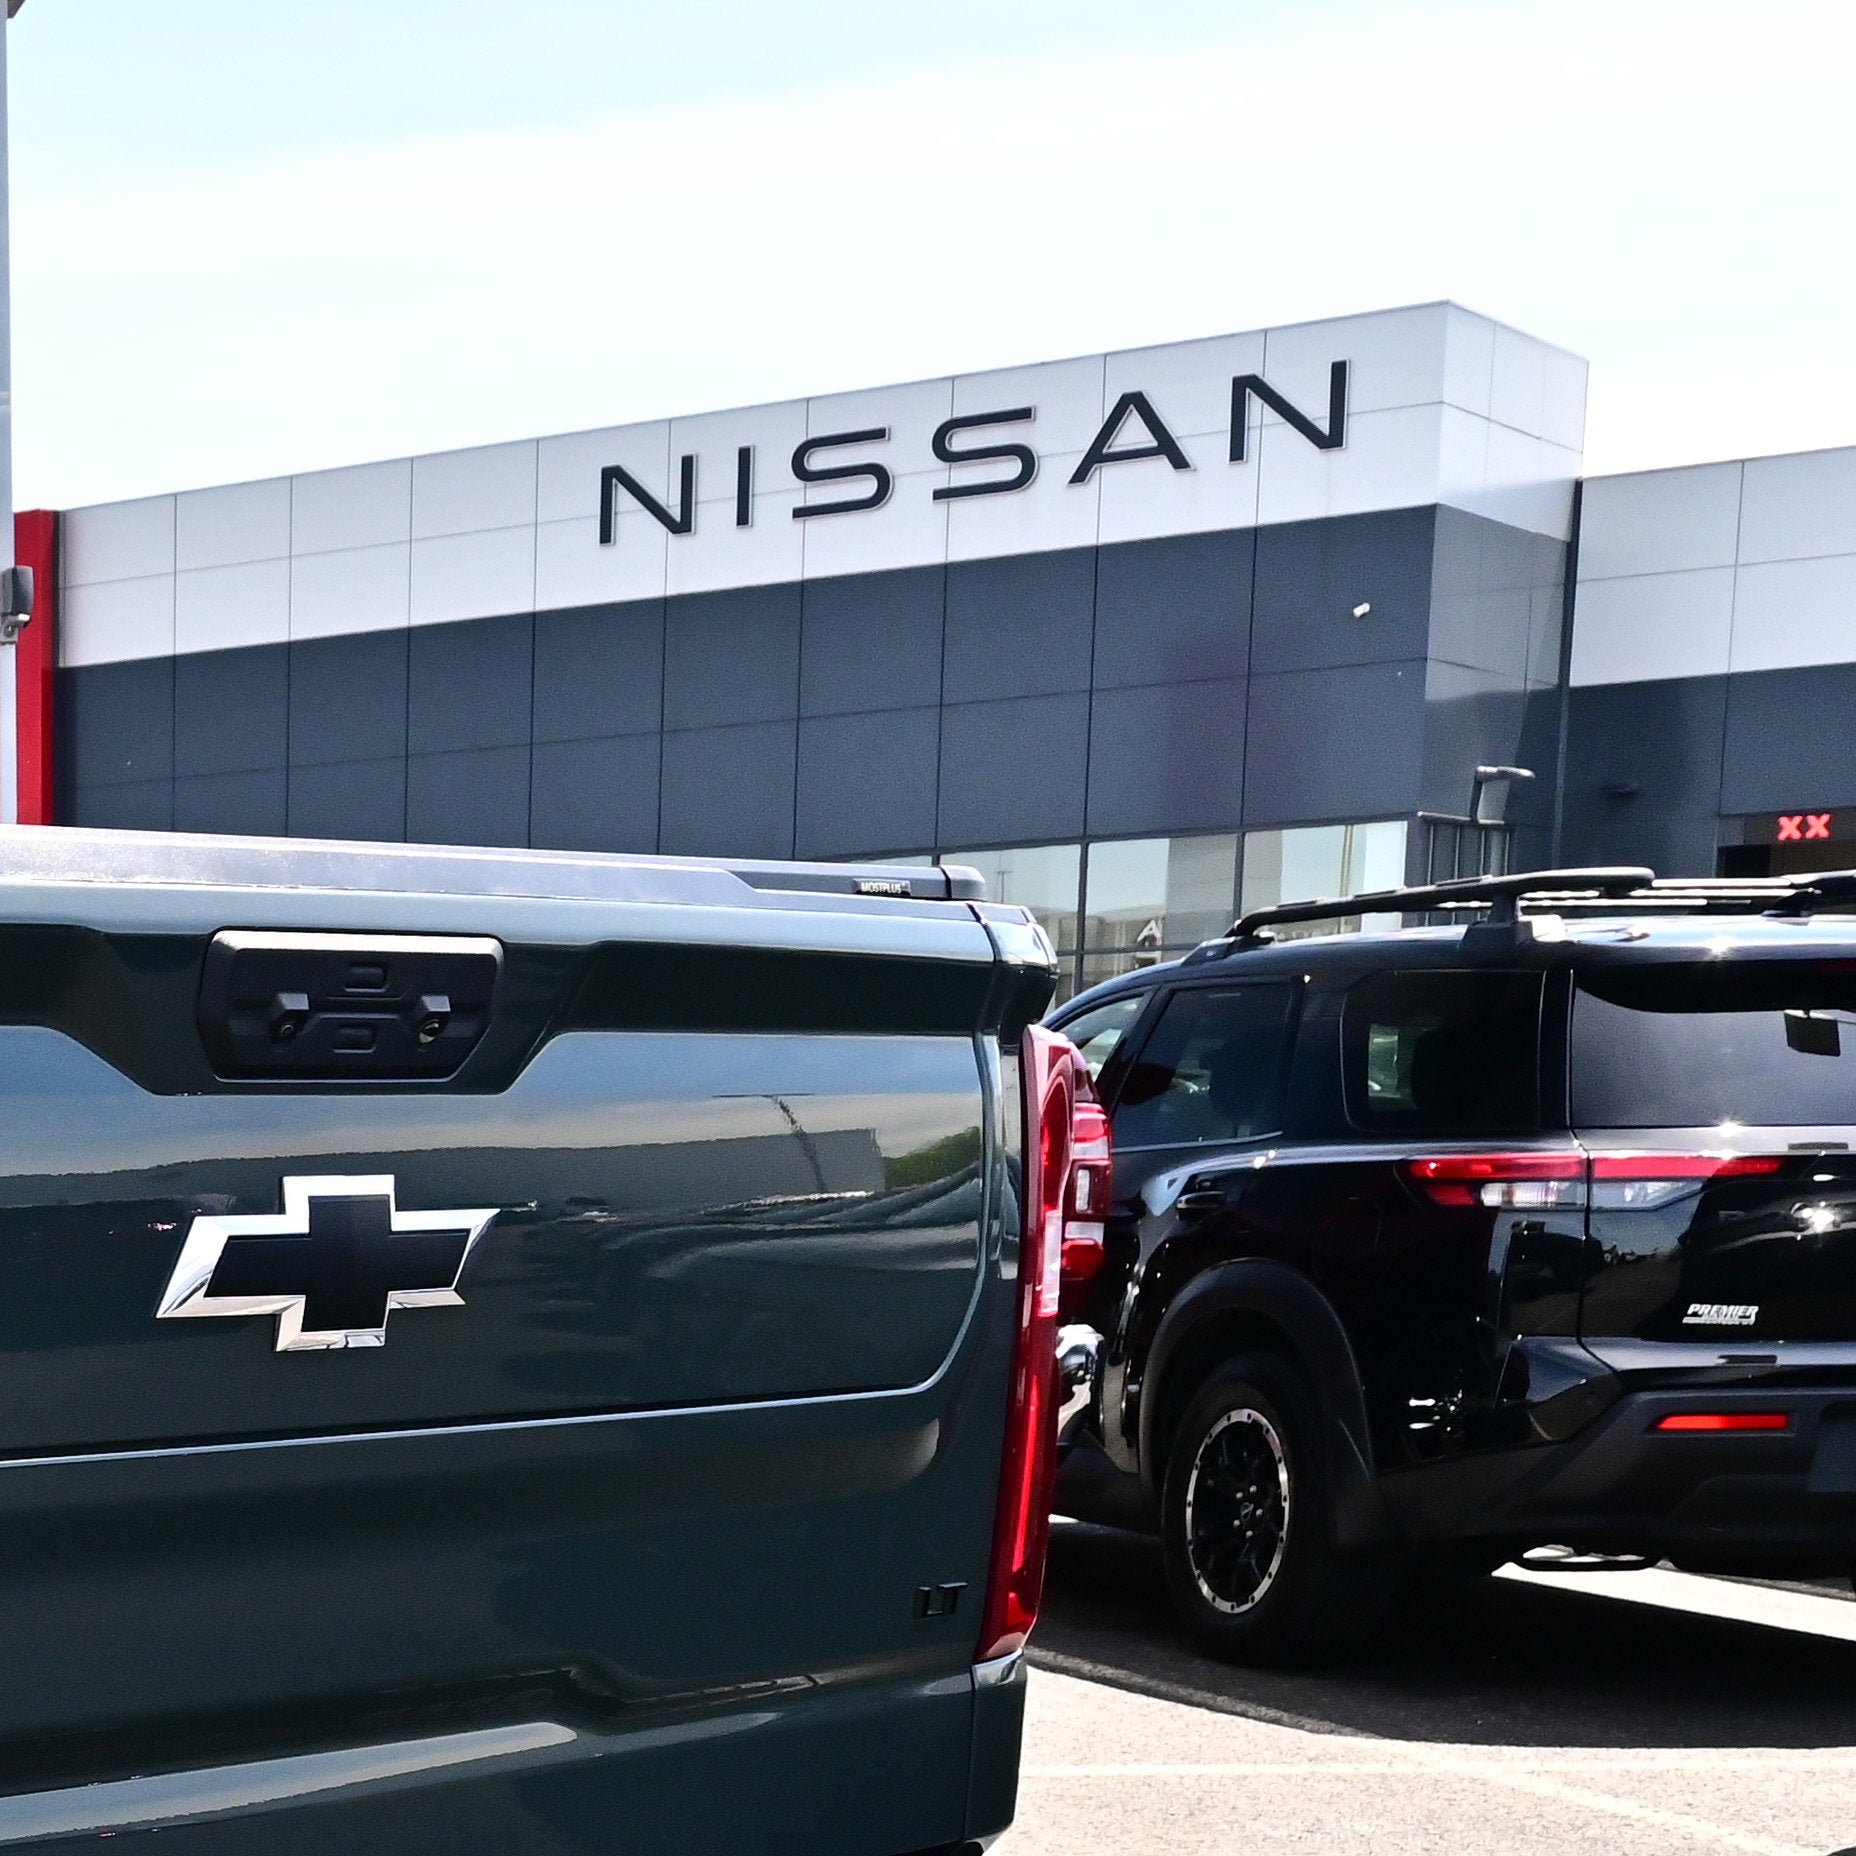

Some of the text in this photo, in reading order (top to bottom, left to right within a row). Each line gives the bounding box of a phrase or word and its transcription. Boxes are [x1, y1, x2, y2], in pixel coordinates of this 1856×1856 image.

[599, 357, 1350, 546] NISSAN
[860, 881, 902, 894] MOSTPLUS
[1687, 1303, 1760, 1317] PREMIER
[915, 1581, 969, 1618] LT
